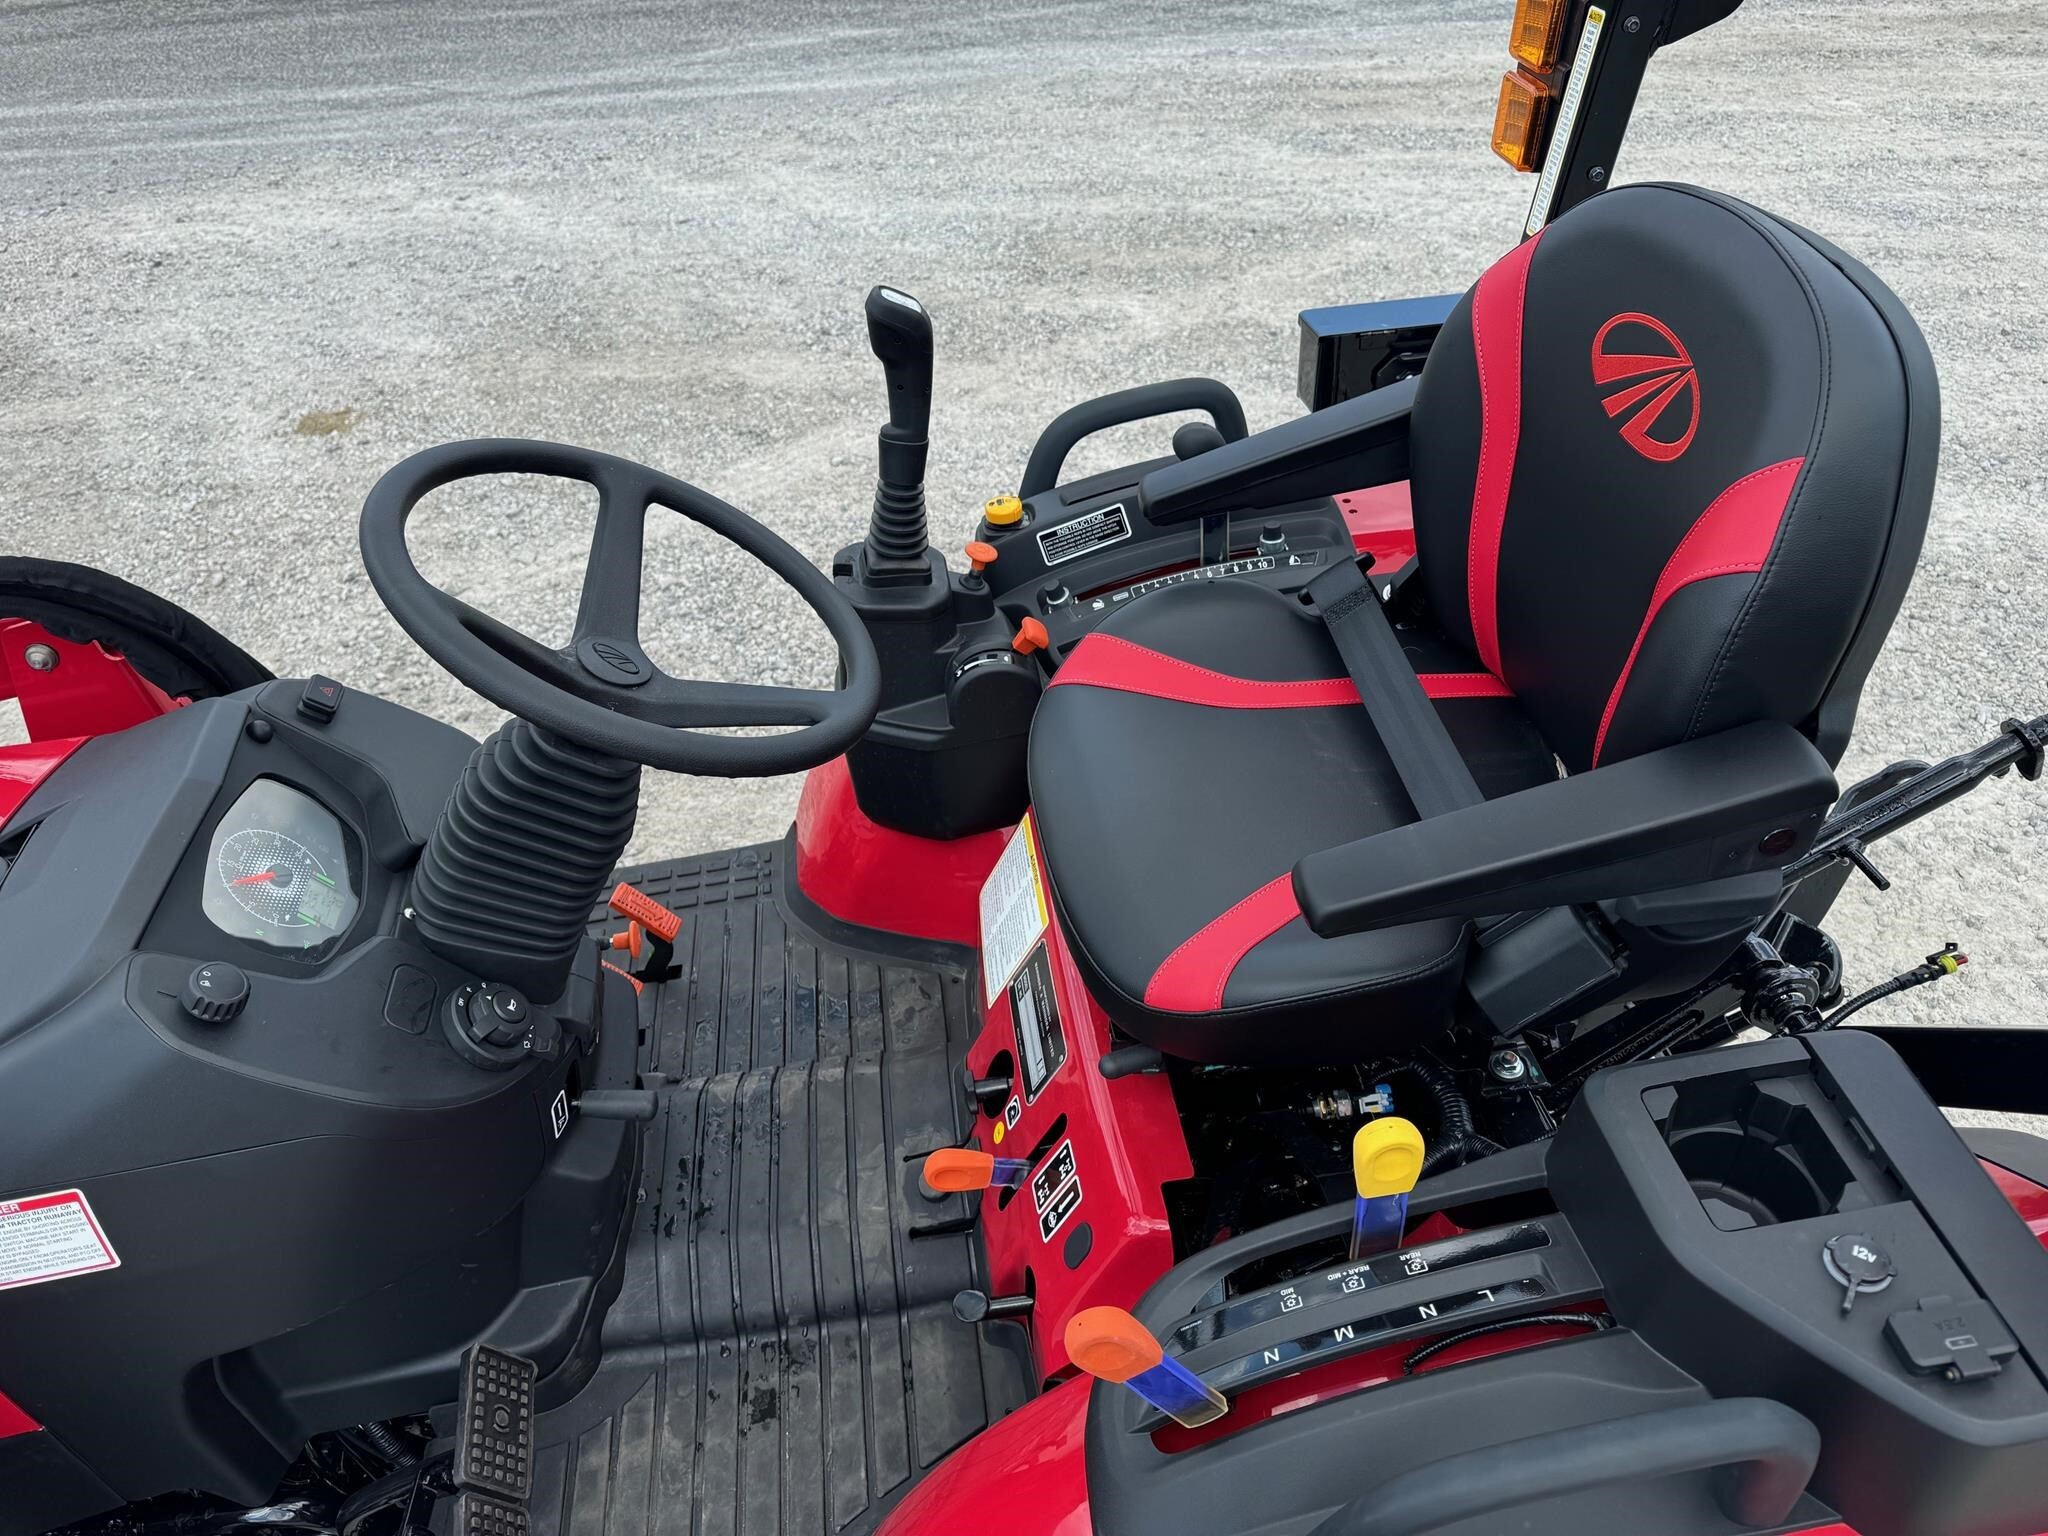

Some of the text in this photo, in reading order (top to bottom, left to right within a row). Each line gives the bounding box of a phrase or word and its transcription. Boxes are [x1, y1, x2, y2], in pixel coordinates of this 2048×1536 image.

[1056, 513, 1105, 538] INSTRUCTION
[1257, 561, 1268, 569] 10
[31, 1207, 58, 1217] INJURY
[7, 1216, 43, 1228] TRACTOR
[44, 1208, 82, 1221] RUNAWAY
[1399, 1250, 1422, 1261] REAR
[1348, 1264, 1370, 1275] REAR
[1327, 1273, 1342, 1281] MID
[1280, 1287, 1294, 1296] MID
[1263, 1289, 1495, 1364] L N M N
